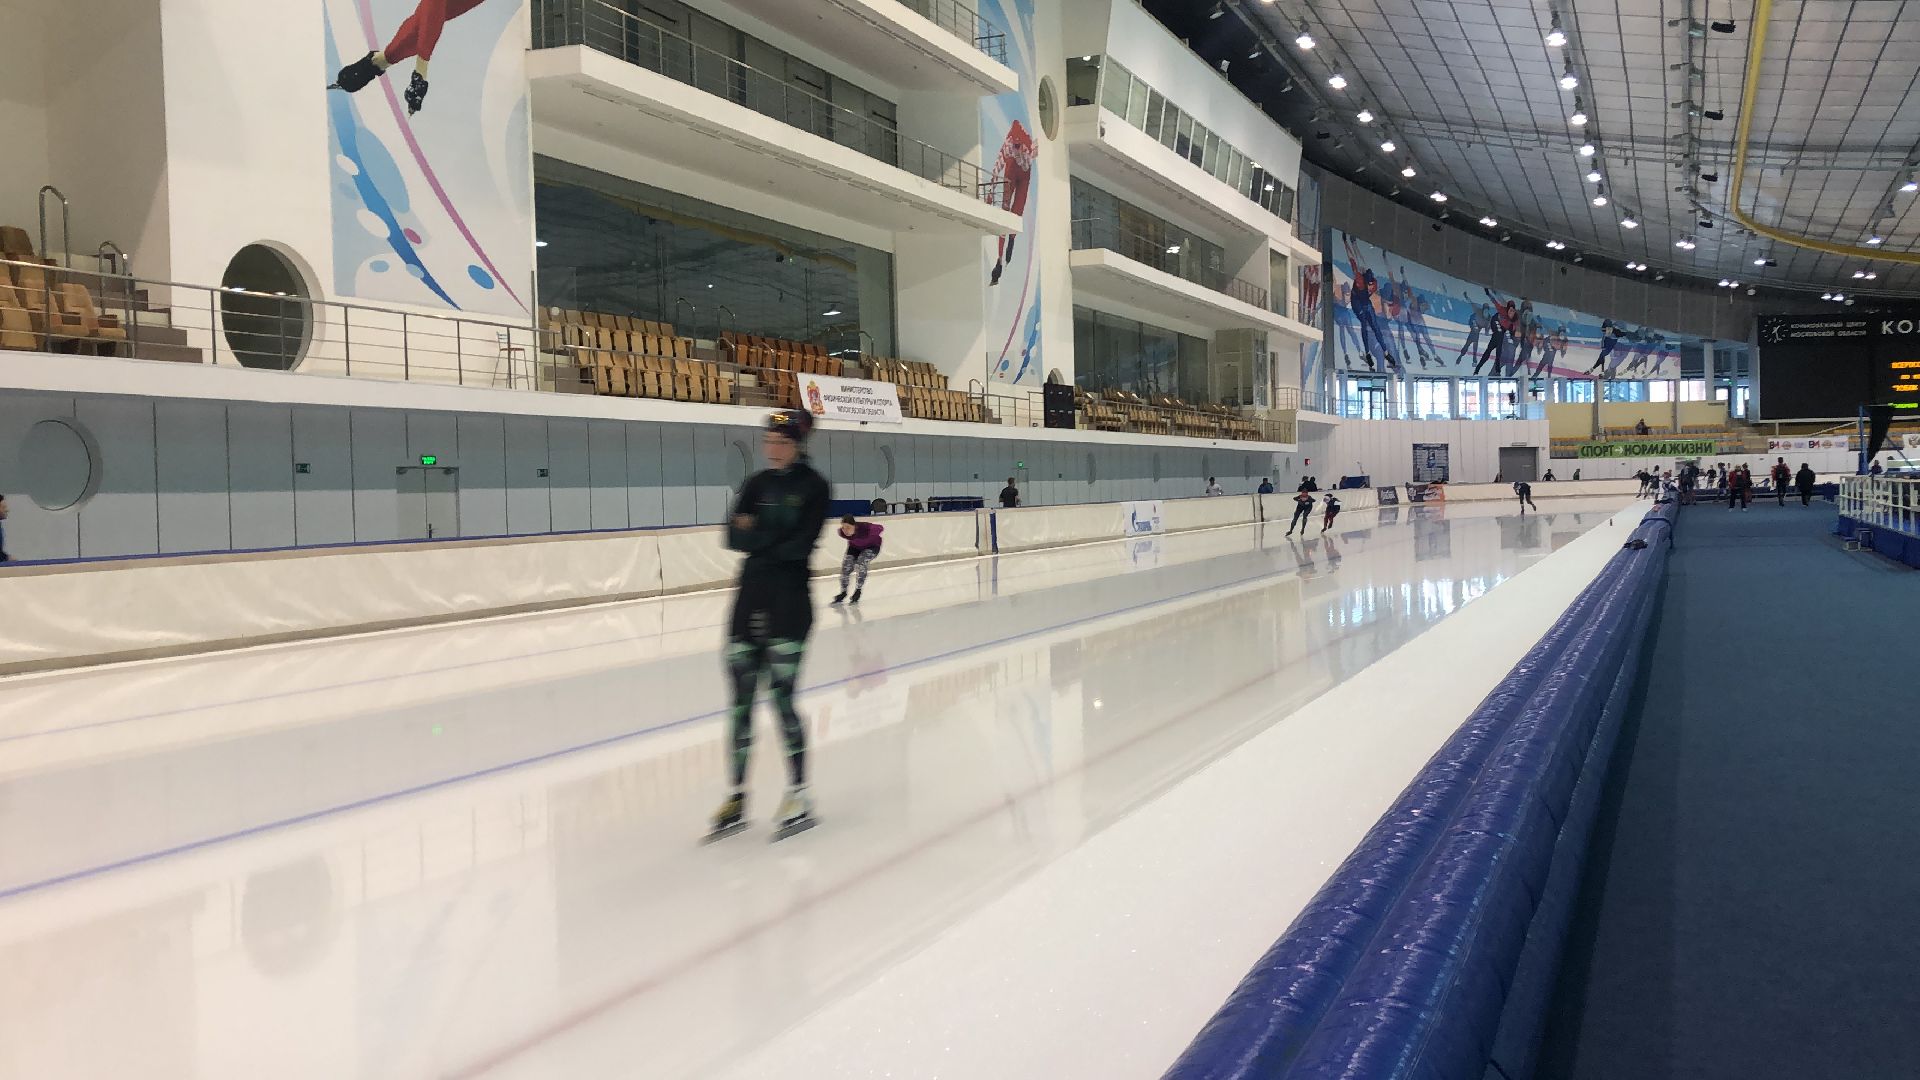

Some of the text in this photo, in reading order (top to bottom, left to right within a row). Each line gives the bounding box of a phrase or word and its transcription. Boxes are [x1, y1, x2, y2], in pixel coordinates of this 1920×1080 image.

[1580, 442, 1713, 457] СПОРТ НОРМА ЖИЗНИ
